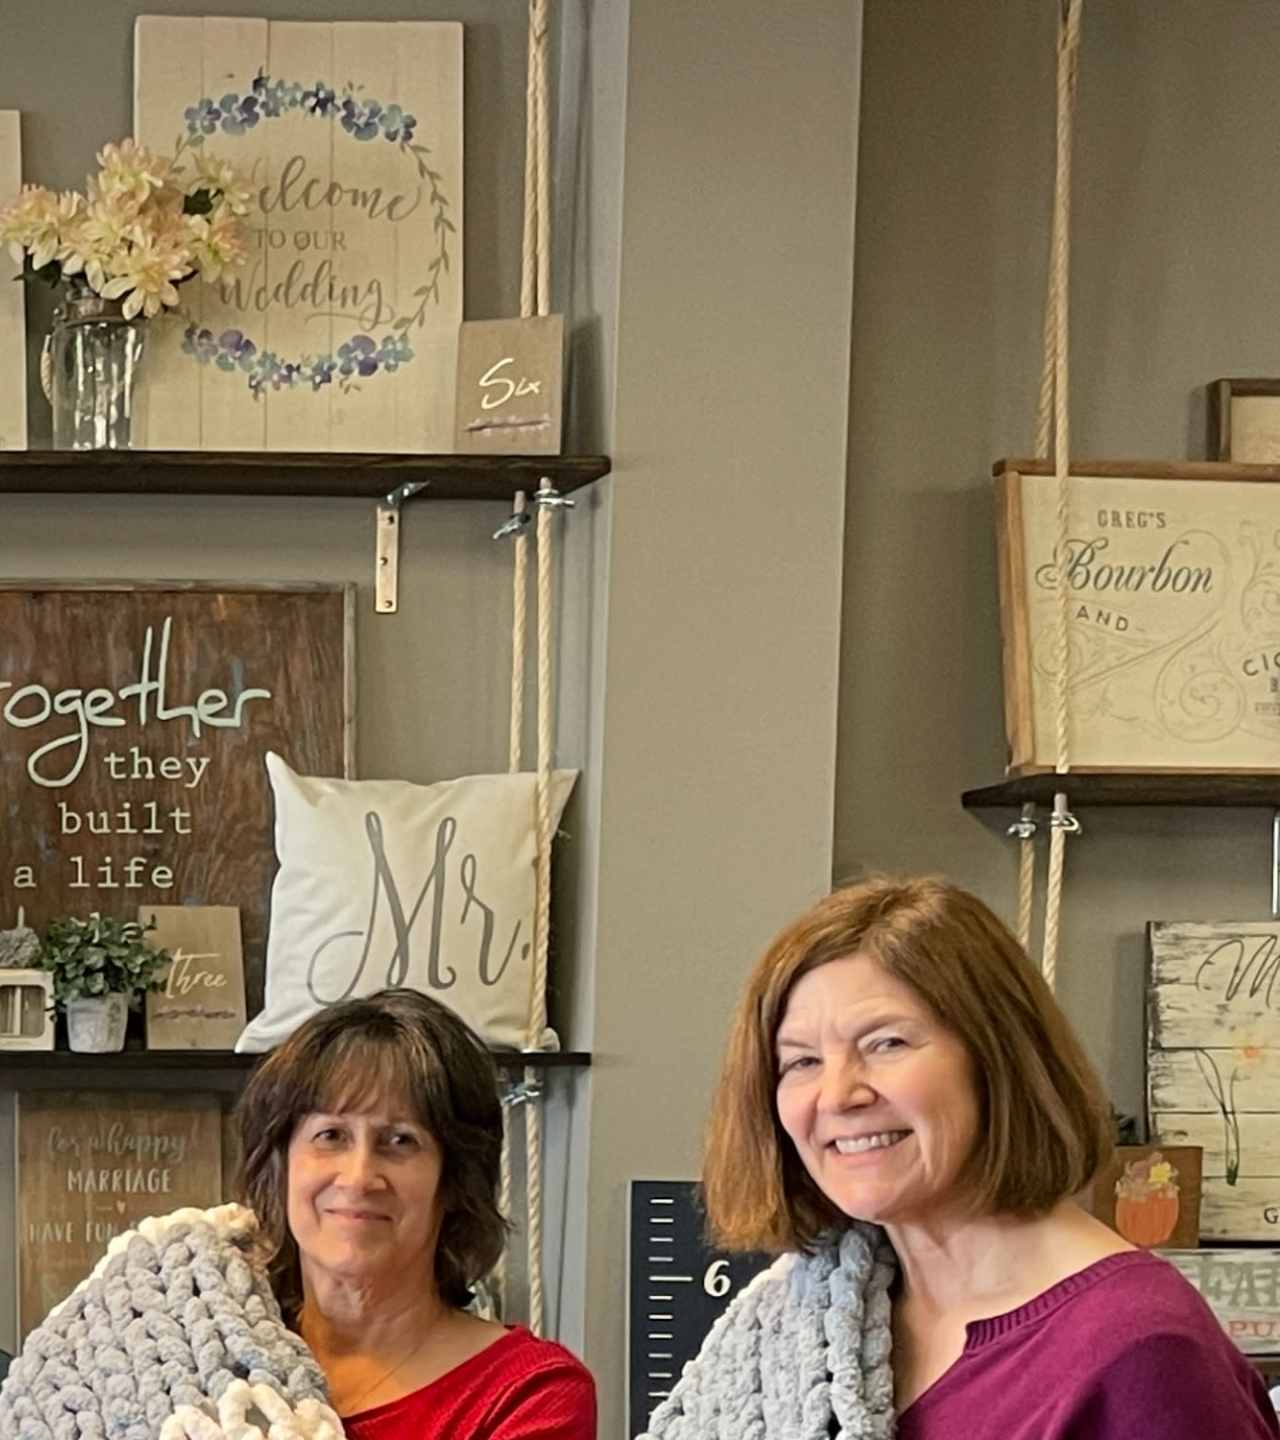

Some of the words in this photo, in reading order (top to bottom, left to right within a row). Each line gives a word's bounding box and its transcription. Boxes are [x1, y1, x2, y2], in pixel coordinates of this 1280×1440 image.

[252, 154, 423, 222] elcome
[255, 228, 287, 250] TO
[293, 230, 347, 252] OUR
[220, 258, 396, 333] Wedding
[1096, 508, 1168, 530] GREG'S
[1035, 536, 1215, 595] Bourbon
[1074, 604, 1131, 633] AND
[103, 746, 211, 789] they
[57, 802, 193, 835] built
[12, 866, 37, 890] a
[68, 855, 175, 889] life
[66, 1167, 173, 1194] MARRIAGE
[29, 1222, 75, 1245] HAVE
[702, 1259, 733, 1298] 6
